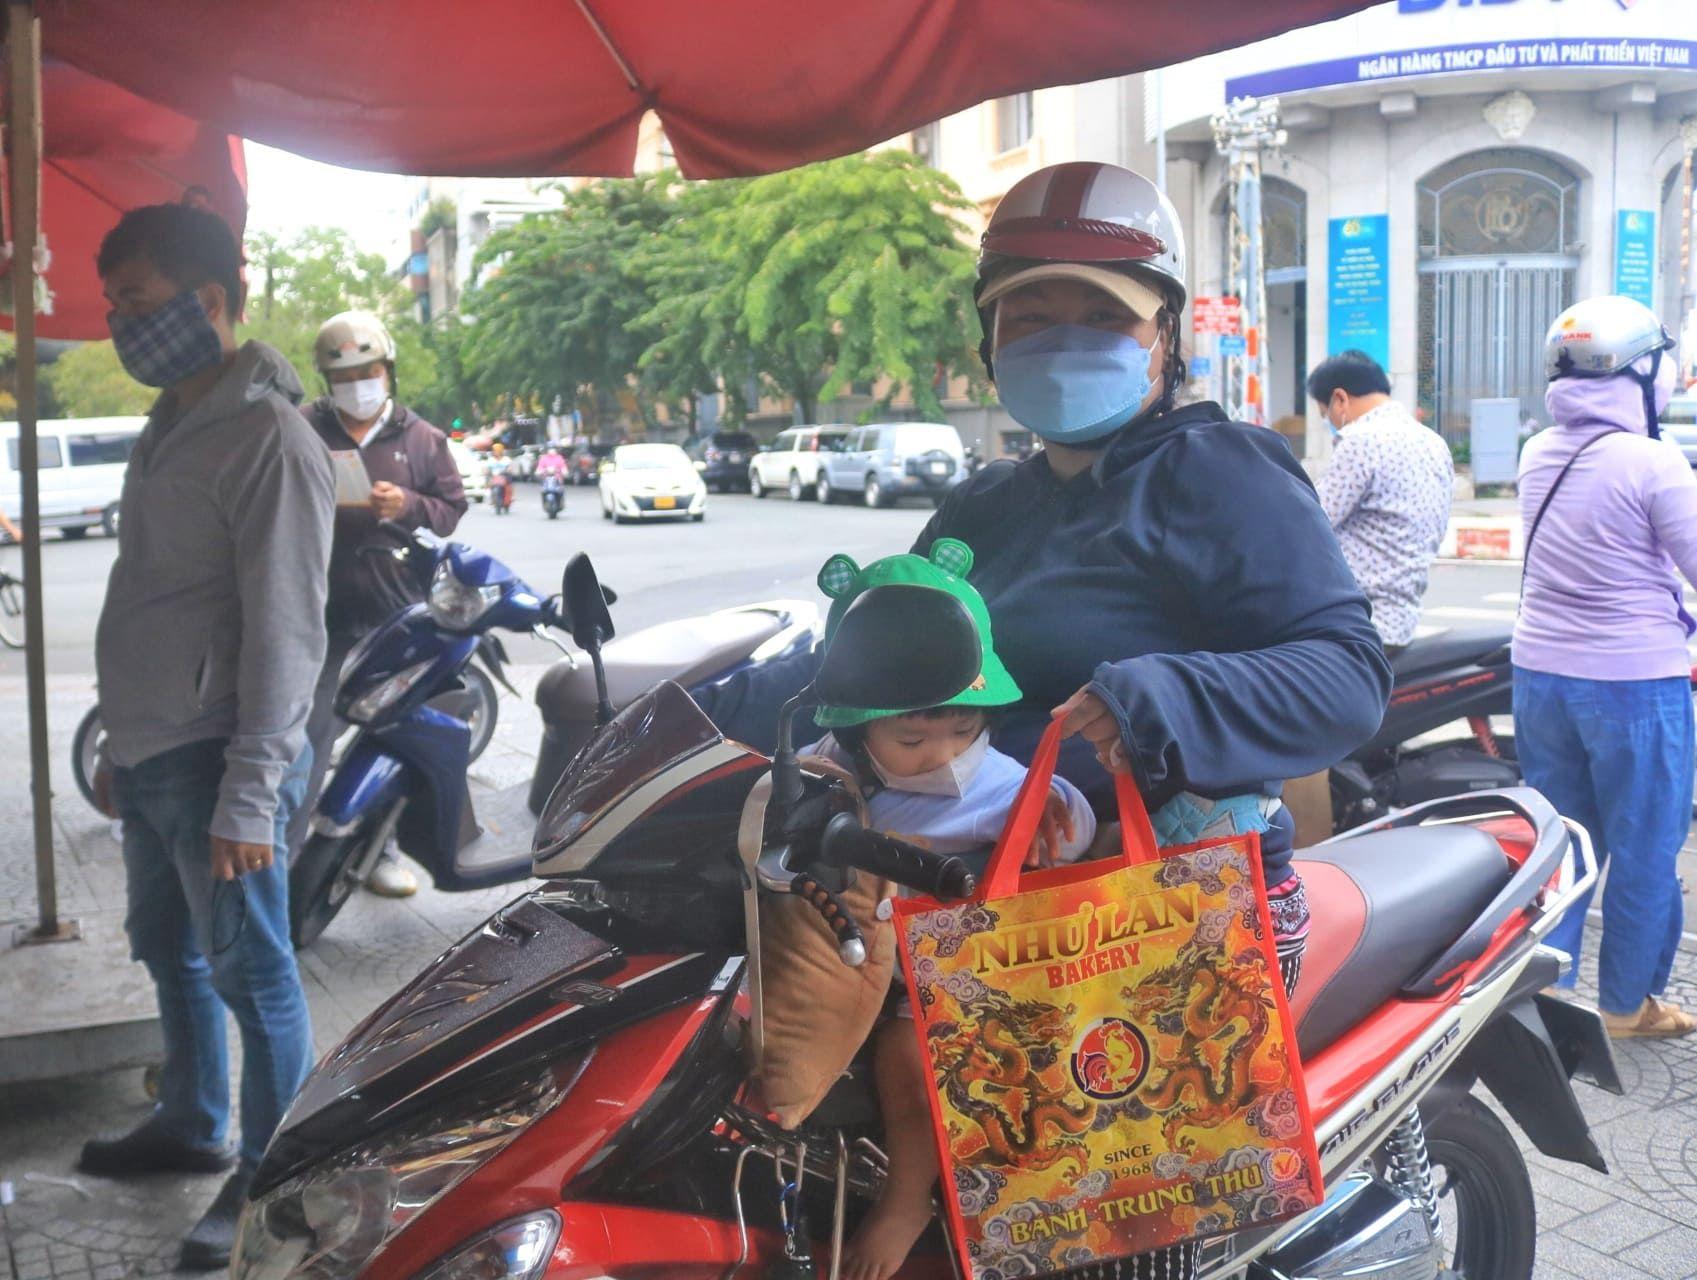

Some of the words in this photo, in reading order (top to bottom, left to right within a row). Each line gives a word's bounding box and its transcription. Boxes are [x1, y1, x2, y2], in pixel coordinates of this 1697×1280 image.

[1358, 55, 1398, 79] NGÂN
[1400, 51, 1442, 73] HÀNG
[1443, 50, 1483, 69] TMCP
[1540, 42, 1558, 63] VÀ
[1561, 42, 1596, 62] PHÁT
[1637, 43, 1663, 67] VIỆT
[1665, 47, 1690, 65] NAM
[1095, 883, 1200, 949] LAN
[1045, 941, 1142, 989] BAKERY
[1104, 1144, 1152, 1165] SINCE
[1112, 1161, 1151, 1180] 1968
[1099, 1182, 1195, 1223] TRUNG
[1205, 1163, 1264, 1199] THU
